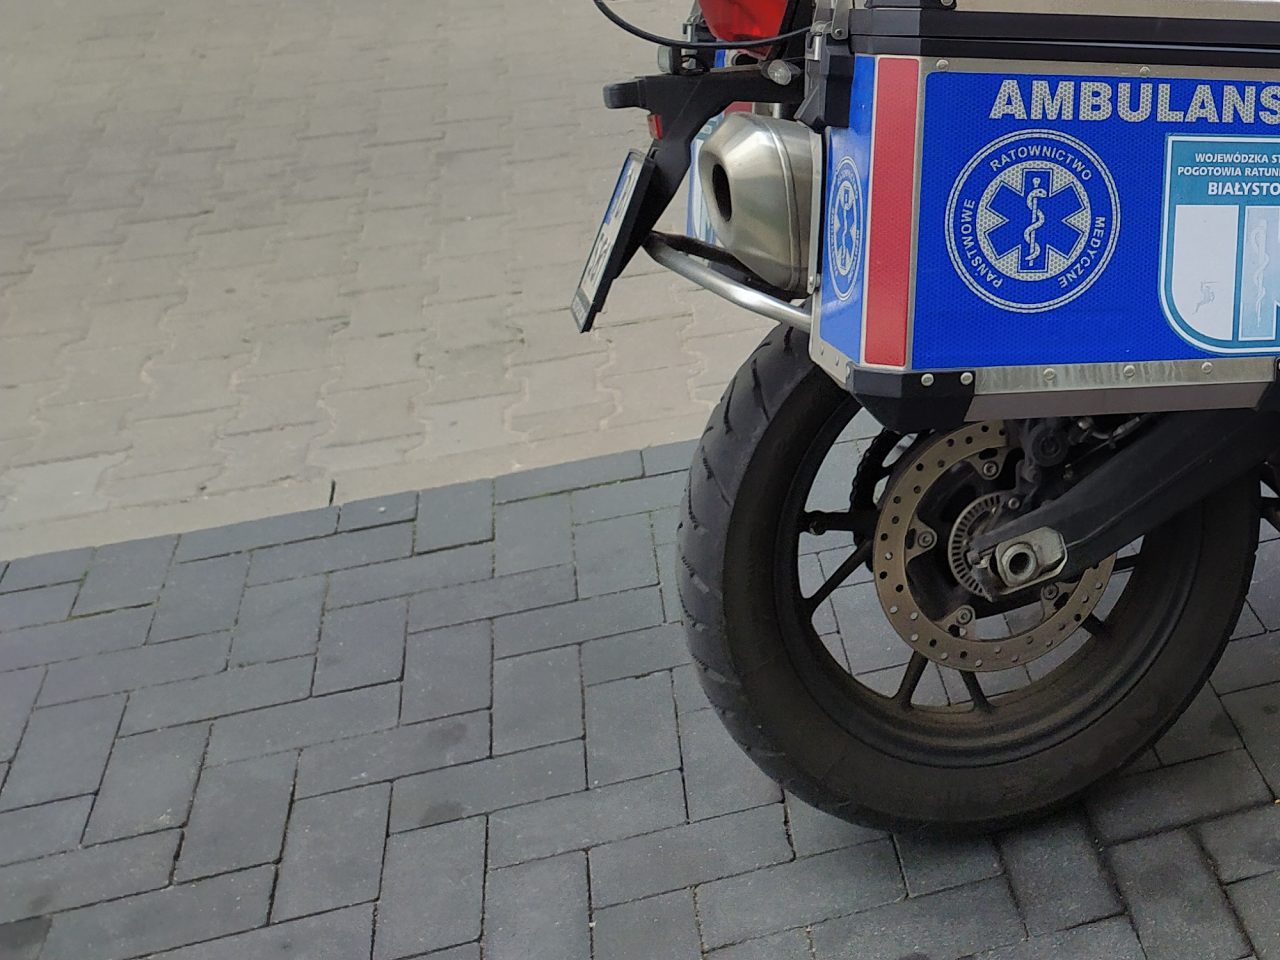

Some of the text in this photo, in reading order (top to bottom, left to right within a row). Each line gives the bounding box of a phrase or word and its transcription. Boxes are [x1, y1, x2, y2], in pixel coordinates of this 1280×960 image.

[989, 144, 1093, 181] RATOWNICTWO
[1177, 166, 1242, 177] POGOTOWIA
[1195, 152, 1269, 164] WOJEWÓDZKA
[960, 198, 1004, 289] PAŃSTWOWE
[1057, 216, 1107, 289] MEDYCZNE
